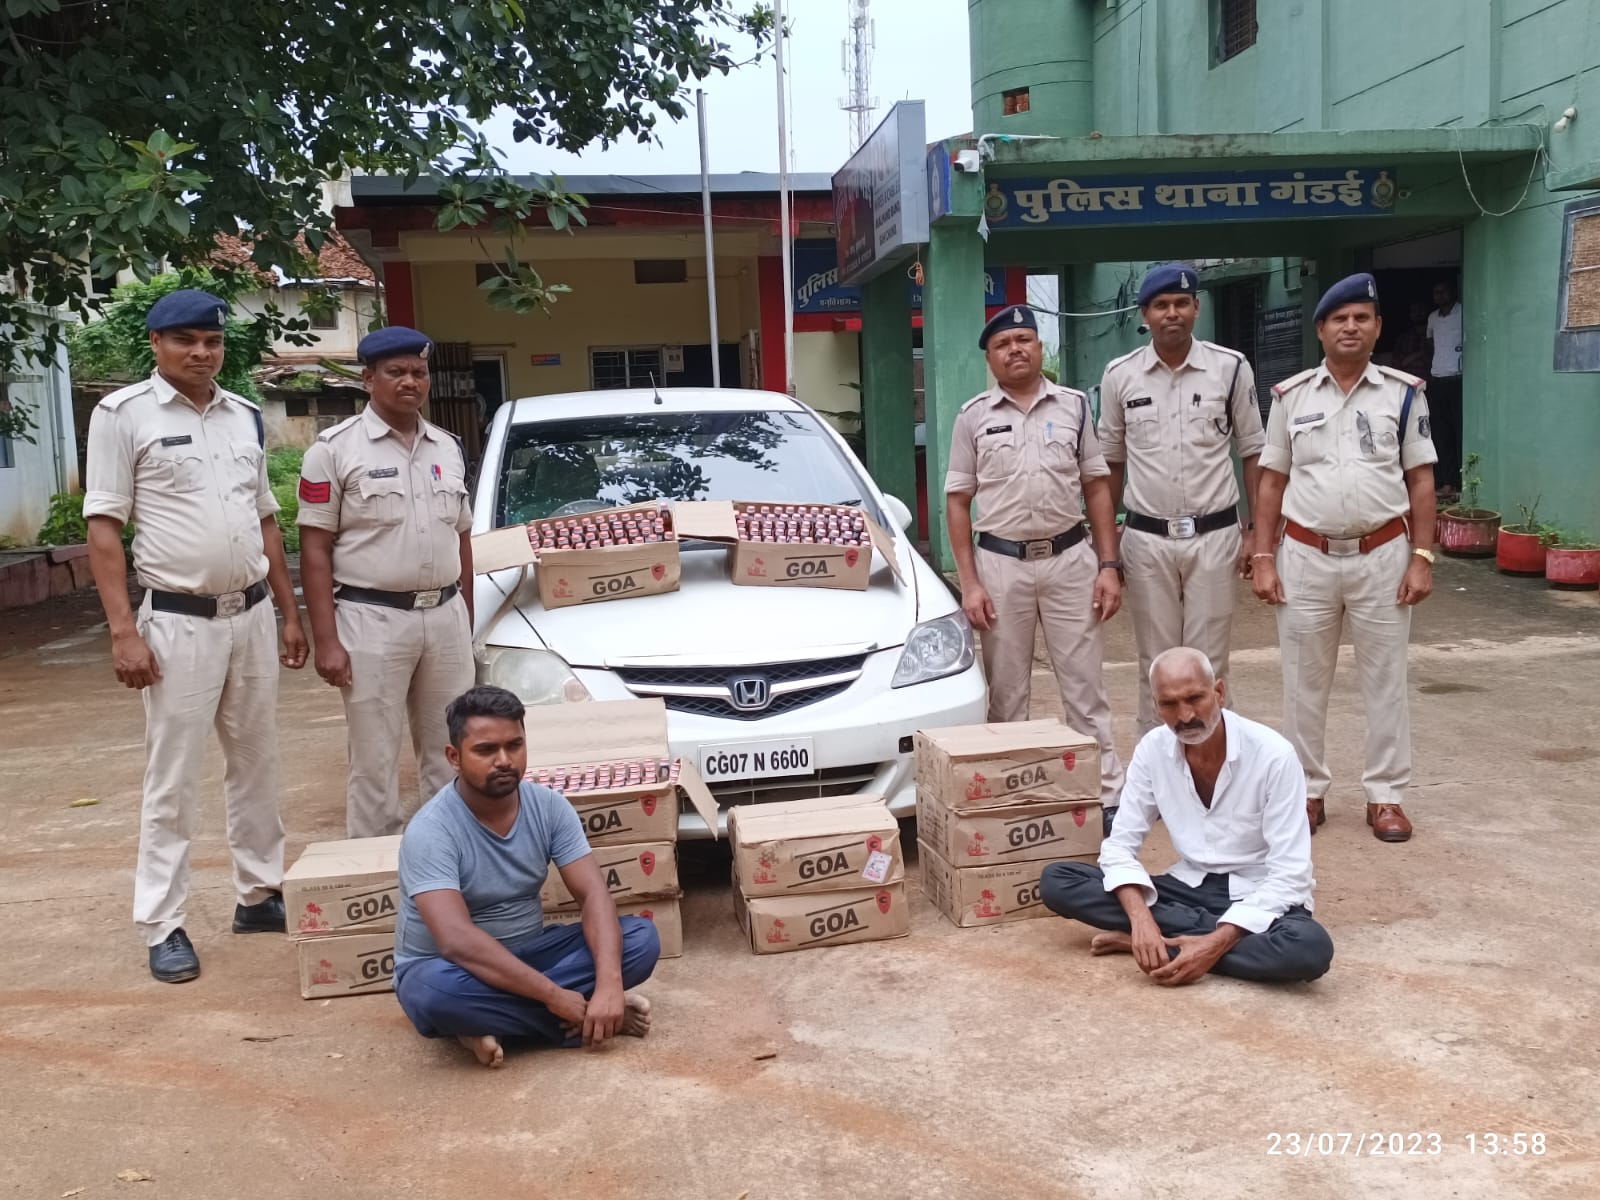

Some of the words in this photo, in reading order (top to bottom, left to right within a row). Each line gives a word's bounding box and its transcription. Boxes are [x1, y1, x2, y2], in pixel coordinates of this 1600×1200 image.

[1013, 179, 1145, 223] पुलिस
[1154, 181, 1261, 208] थाना
[1269, 170, 1364, 207] गंडई
[786, 560, 828, 577] GOA
[592, 575, 636, 595] GOA
[706, 753, 748, 775] CG07
[754, 752, 765, 772] N
[770, 748, 809, 770] 6600
[1005, 765, 1048, 790] GOA
[1008, 819, 1055, 847] GOA
[798, 852, 849, 880] GOA
[346, 894, 395, 920] GOA
[1016, 885, 1041, 905] GO
[809, 908, 859, 938] GOA
[361, 954, 395, 980] GO
